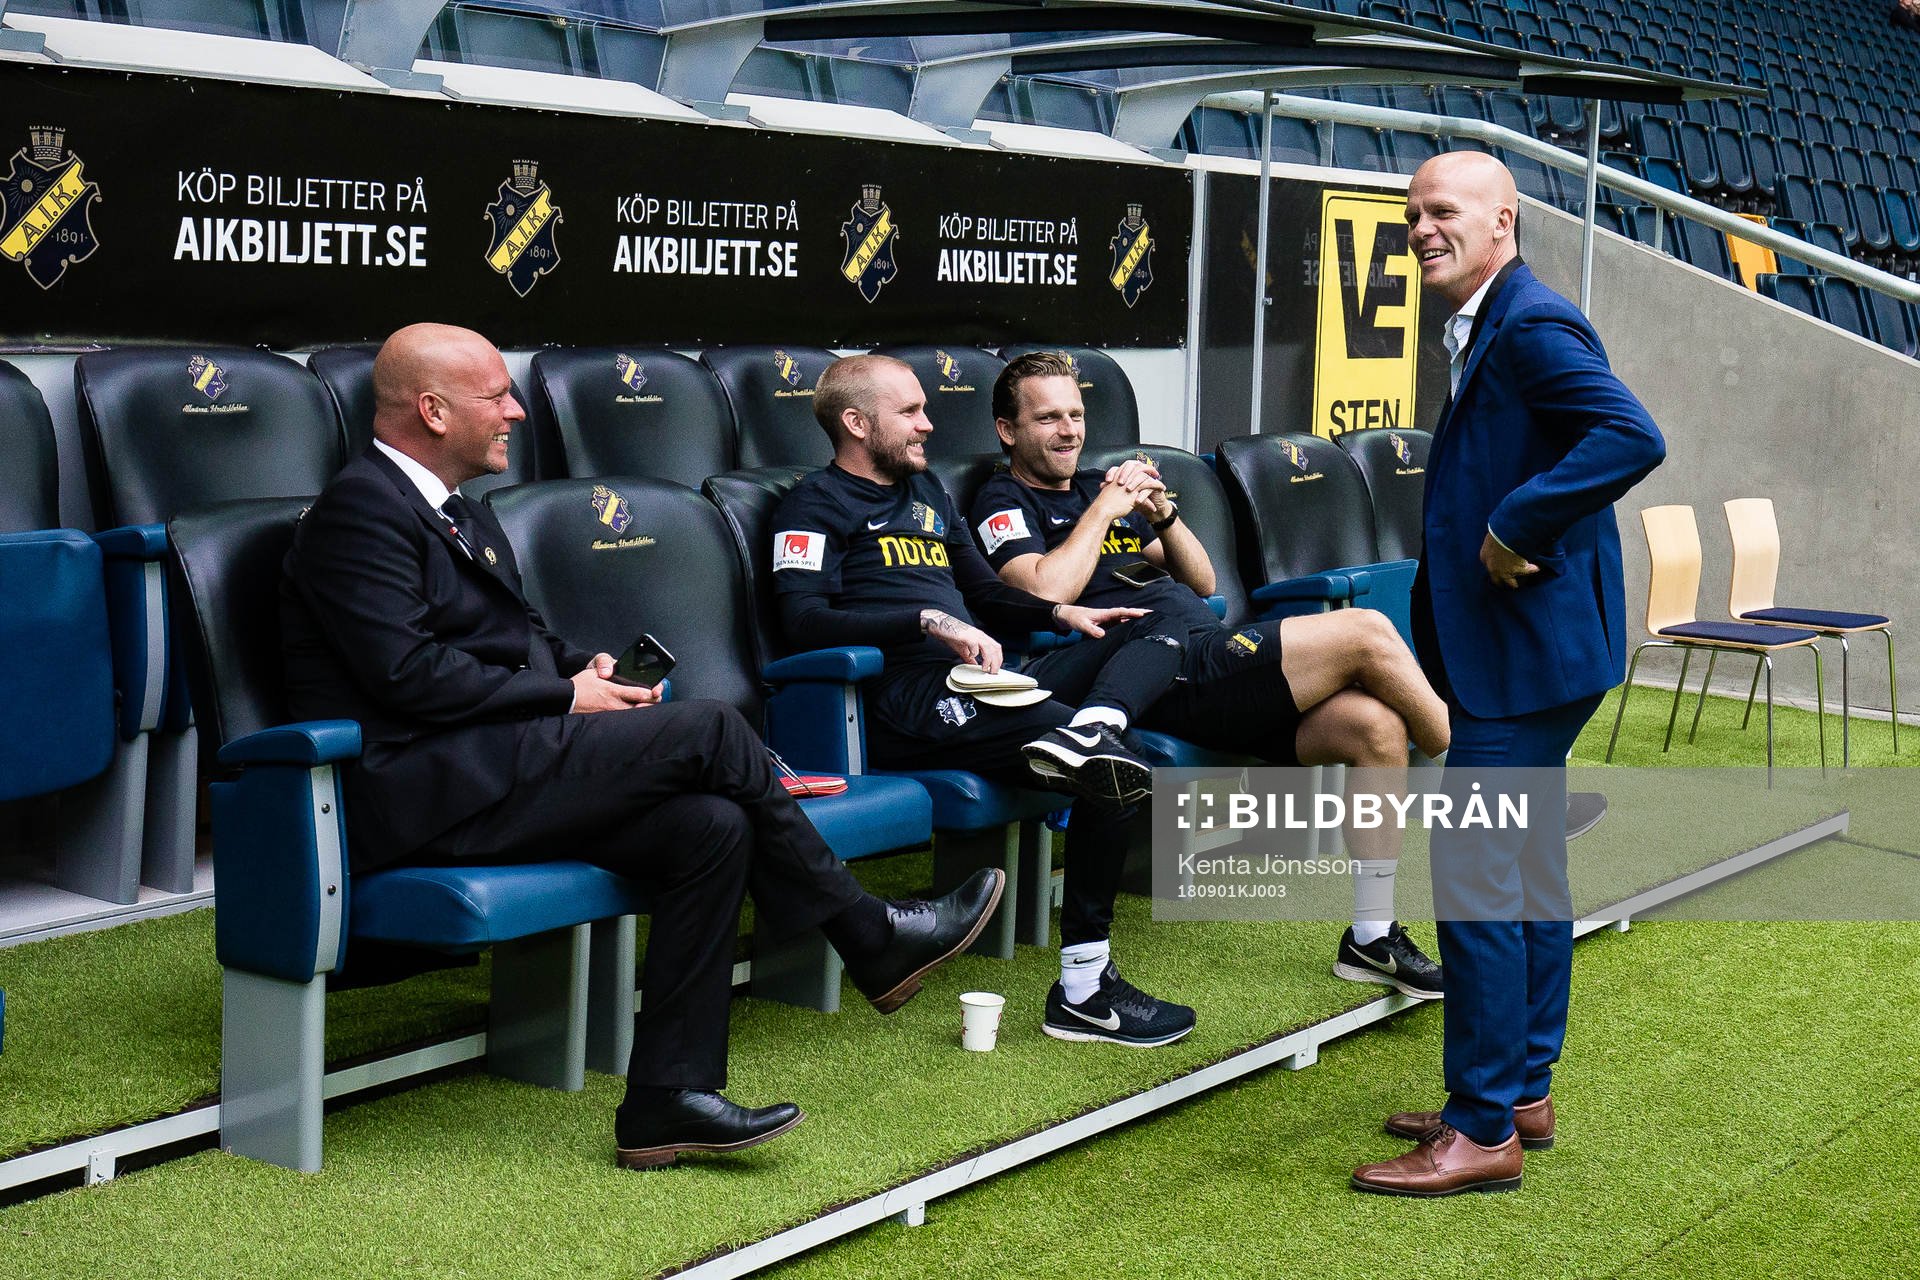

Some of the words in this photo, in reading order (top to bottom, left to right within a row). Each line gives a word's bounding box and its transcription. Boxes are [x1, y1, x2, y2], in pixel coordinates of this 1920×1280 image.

[177, 166, 237, 204] KÖP
[246, 174, 386, 212] BILJETTER
[396, 176, 428, 214] PÅ
[616, 192, 660, 224] KÖP
[666, 199, 769, 230] BILJETTER
[775, 199, 800, 231] PÅ
[938, 212, 973, 240] KÖP
[976, 217, 1055, 244] BILJETTER
[1059, 217, 1079, 246] PÅ
[173, 216, 428, 267] AIKBILJETT.SE
[612, 234, 799, 278] AIKBILJETT.SE
[936, 248, 1078, 286] AIKBILJETT.SE
